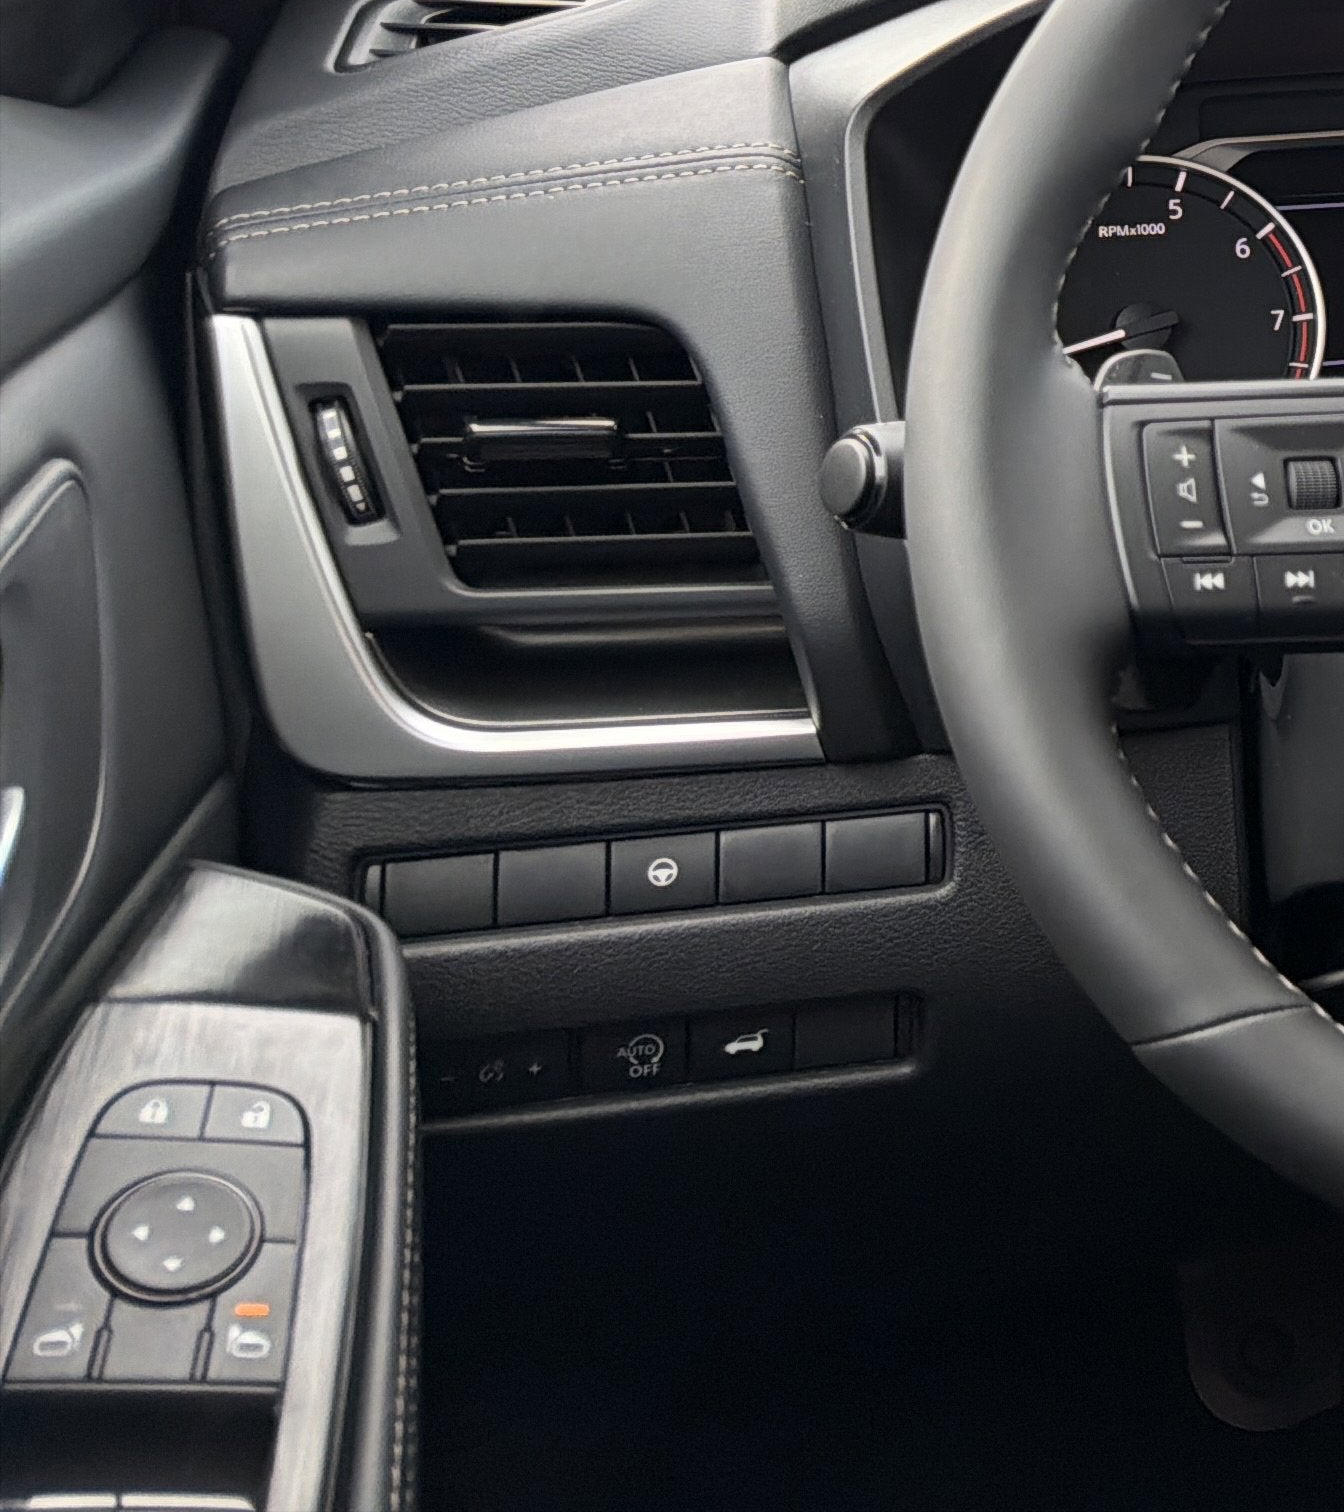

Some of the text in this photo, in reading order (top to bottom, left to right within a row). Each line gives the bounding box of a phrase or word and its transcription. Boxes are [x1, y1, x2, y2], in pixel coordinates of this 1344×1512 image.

[1168, 198, 1183, 220] 5
[1098, 222, 1166, 238] RPMx1000
[1235, 237, 1251, 259] 6
[1270, 309, 1284, 331] 7
[1305, 518, 1336, 536] OK
[616, 1043, 656, 1058] AUTO
[629, 1063, 660, 1078] OFF
